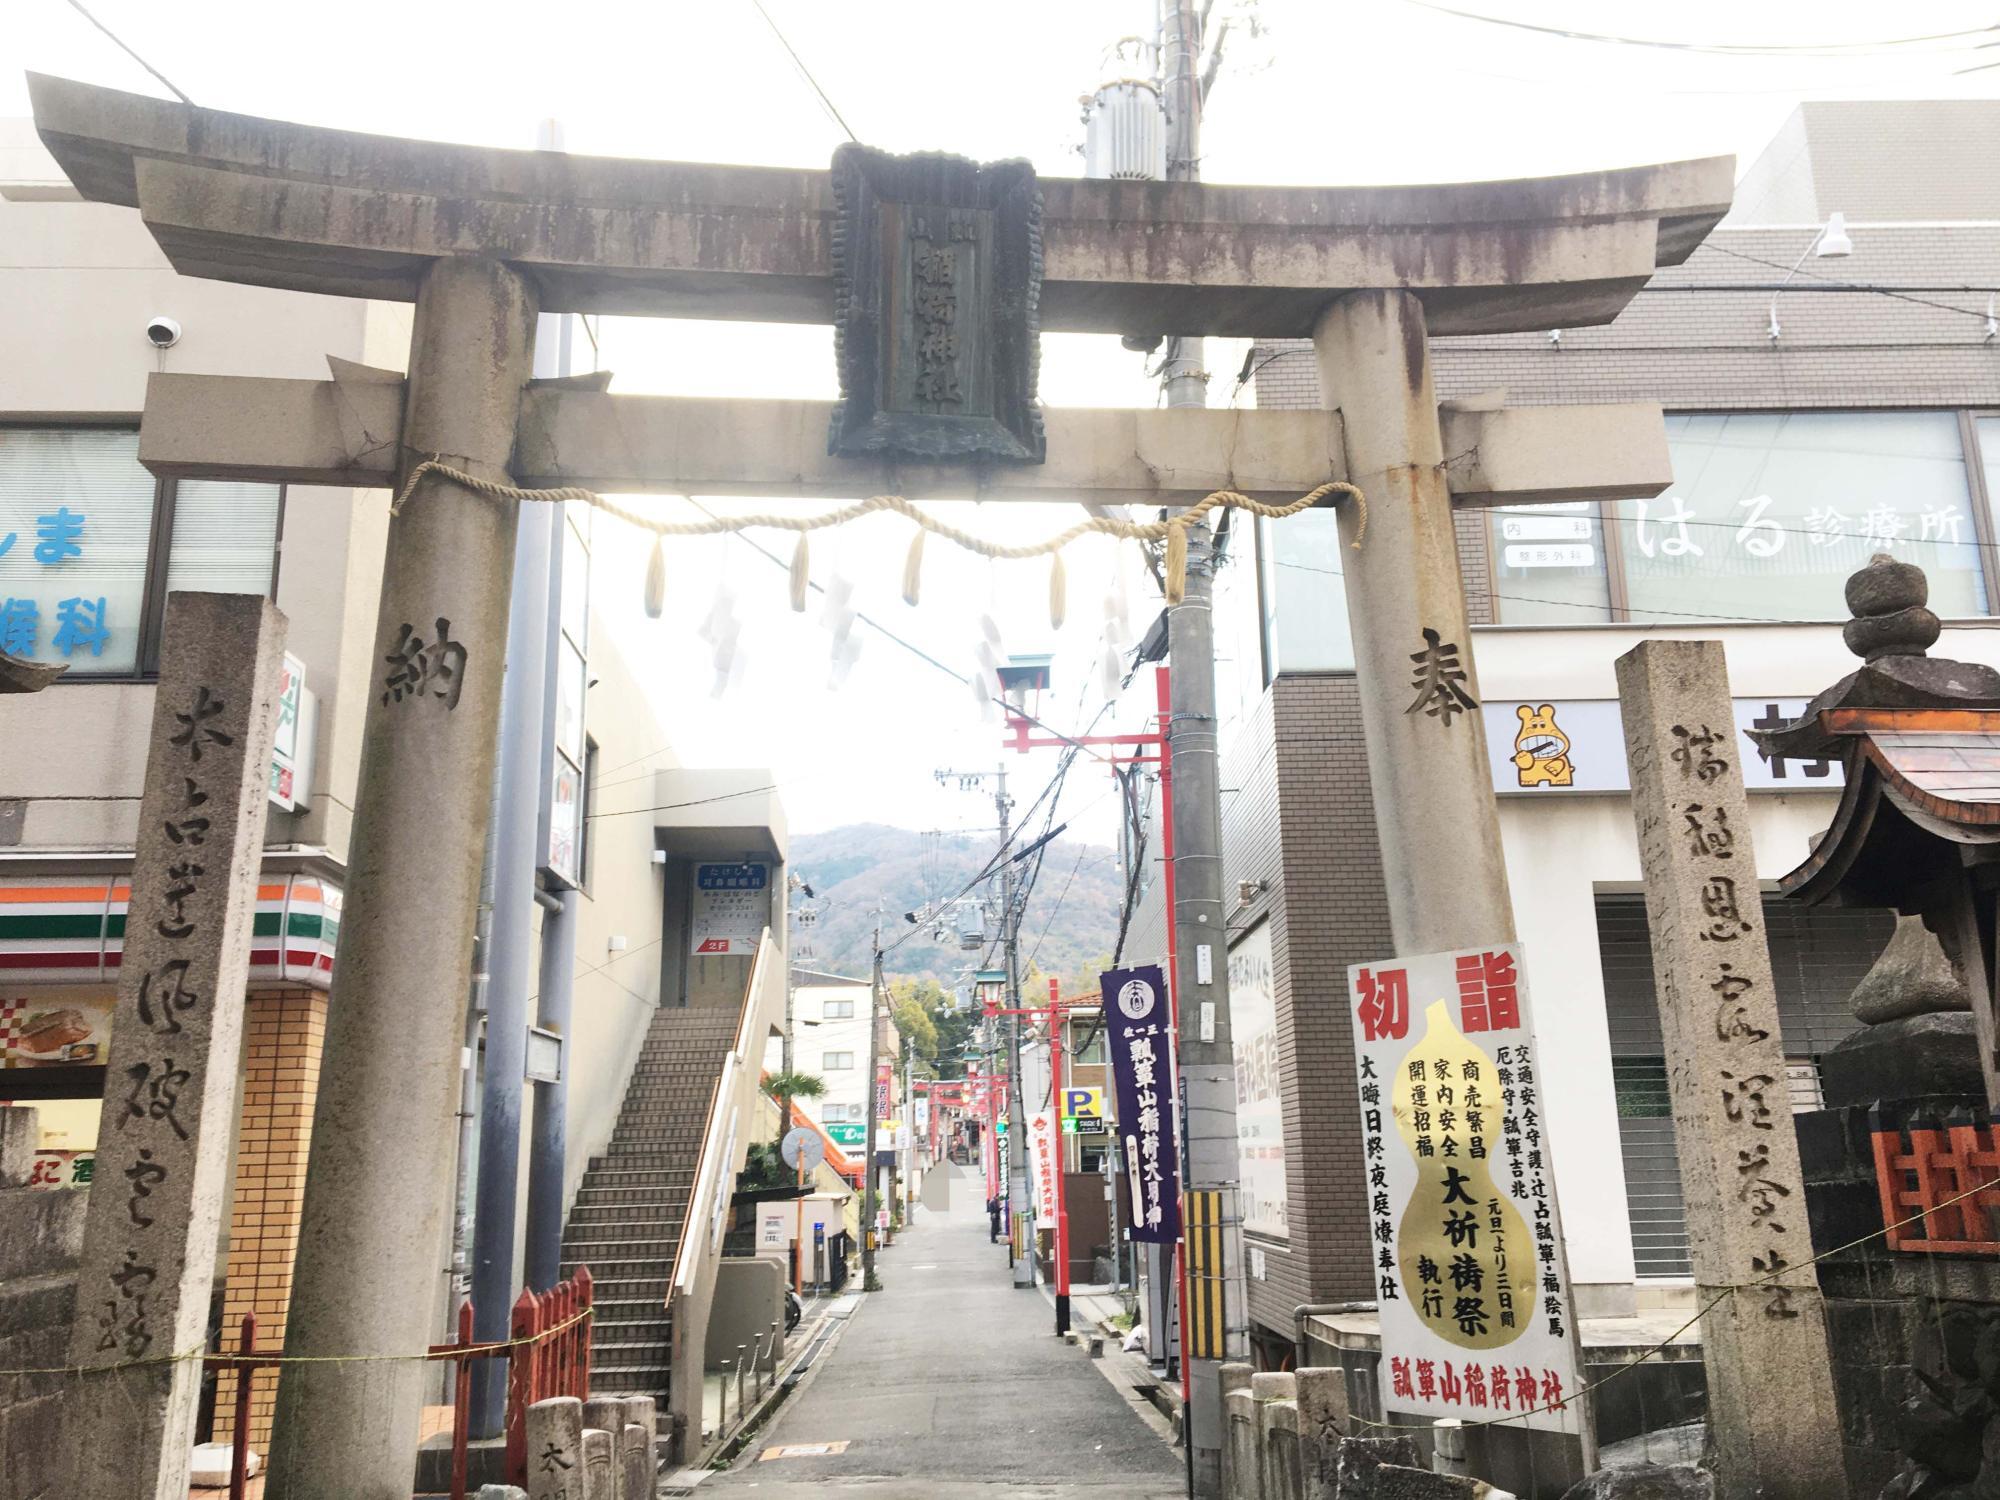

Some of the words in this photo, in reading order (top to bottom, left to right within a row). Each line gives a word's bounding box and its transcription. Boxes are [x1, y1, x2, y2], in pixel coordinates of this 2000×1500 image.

[1635, 494, 1966, 559] はる診療所
[380, 616, 468, 712] 納
[1404, 627, 1478, 728] 奉
[708, 941, 727, 951] 2F
[1356, 951, 1521, 1042] 初詣
[1067, 1090, 1093, 1117] P
[1408, 1060, 1435, 1159] 開運招福
[1434, 1058, 1459, 1159] 家内安全
[1462, 1059, 1487, 1160] 商売繁昌
[1416, 1254, 1445, 1320] 執行
